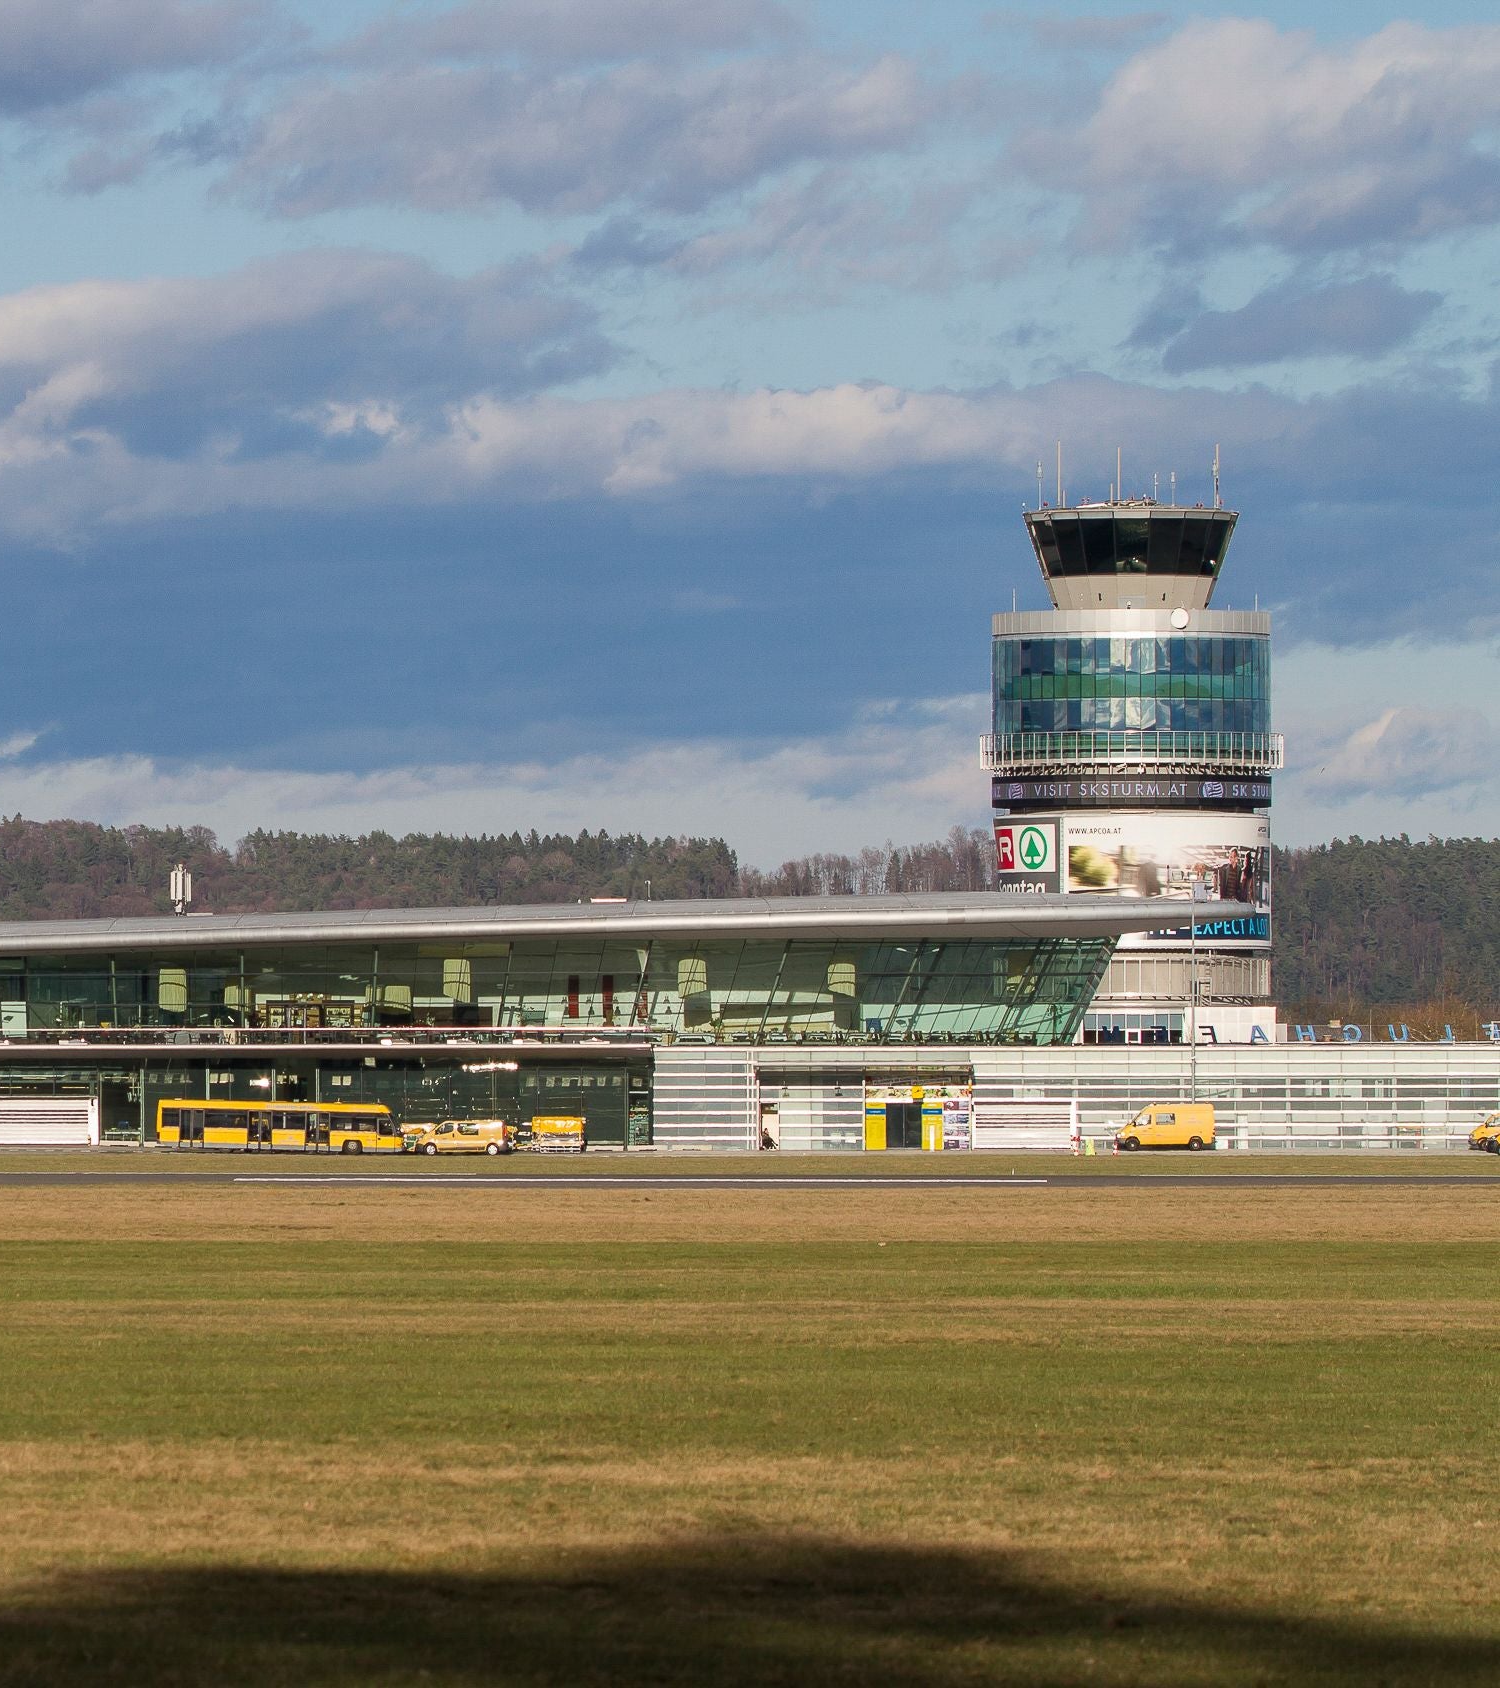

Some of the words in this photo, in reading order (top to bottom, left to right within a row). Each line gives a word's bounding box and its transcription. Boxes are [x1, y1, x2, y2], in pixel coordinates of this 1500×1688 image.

[1034, 783, 1071, 797] VISIT
[1079, 783, 1188, 797] SKSTURM.AT
[1232, 784, 1248, 797] SK
[1068, 827, 1122, 835] WWW.APCOA.AT
[1193, 918, 1246, 935] EXPECT
[1249, 918, 1256, 936] A
